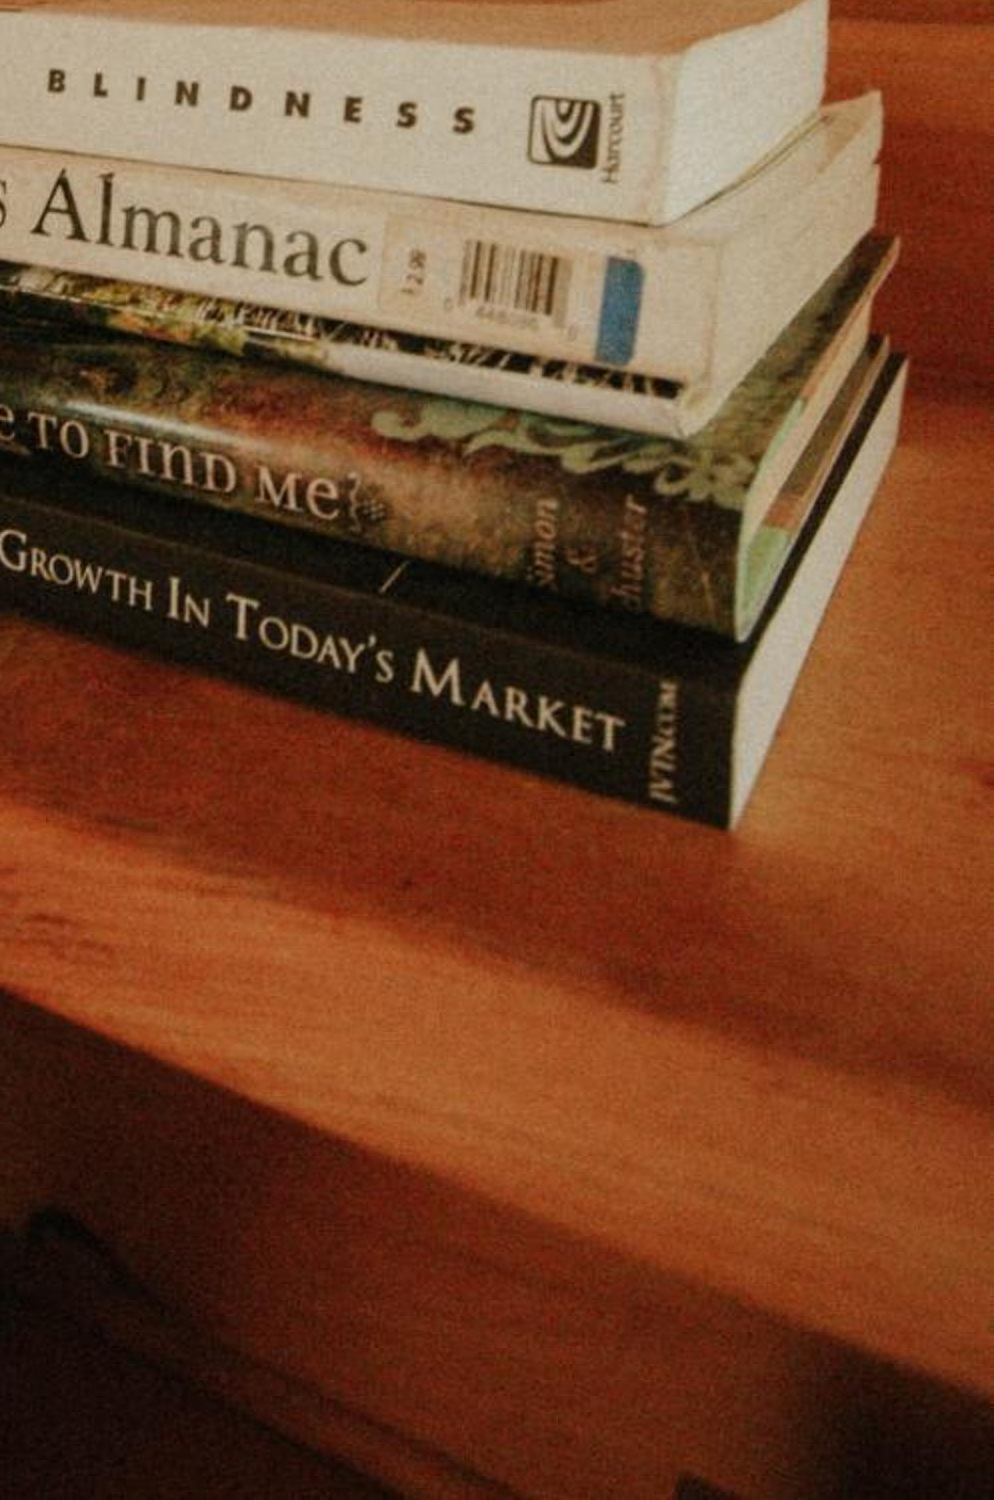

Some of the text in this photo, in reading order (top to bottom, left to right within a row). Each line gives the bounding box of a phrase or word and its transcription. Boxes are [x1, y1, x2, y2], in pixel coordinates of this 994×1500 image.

[49, 68, 476, 134] BLINDNESS
[602, 93, 626, 183] Harcourt
[31, 167, 369, 286] Almanac
[28, 411, 90, 459] TO
[168, 576, 210, 628] IN
[410, 647, 626, 753] MARKET
